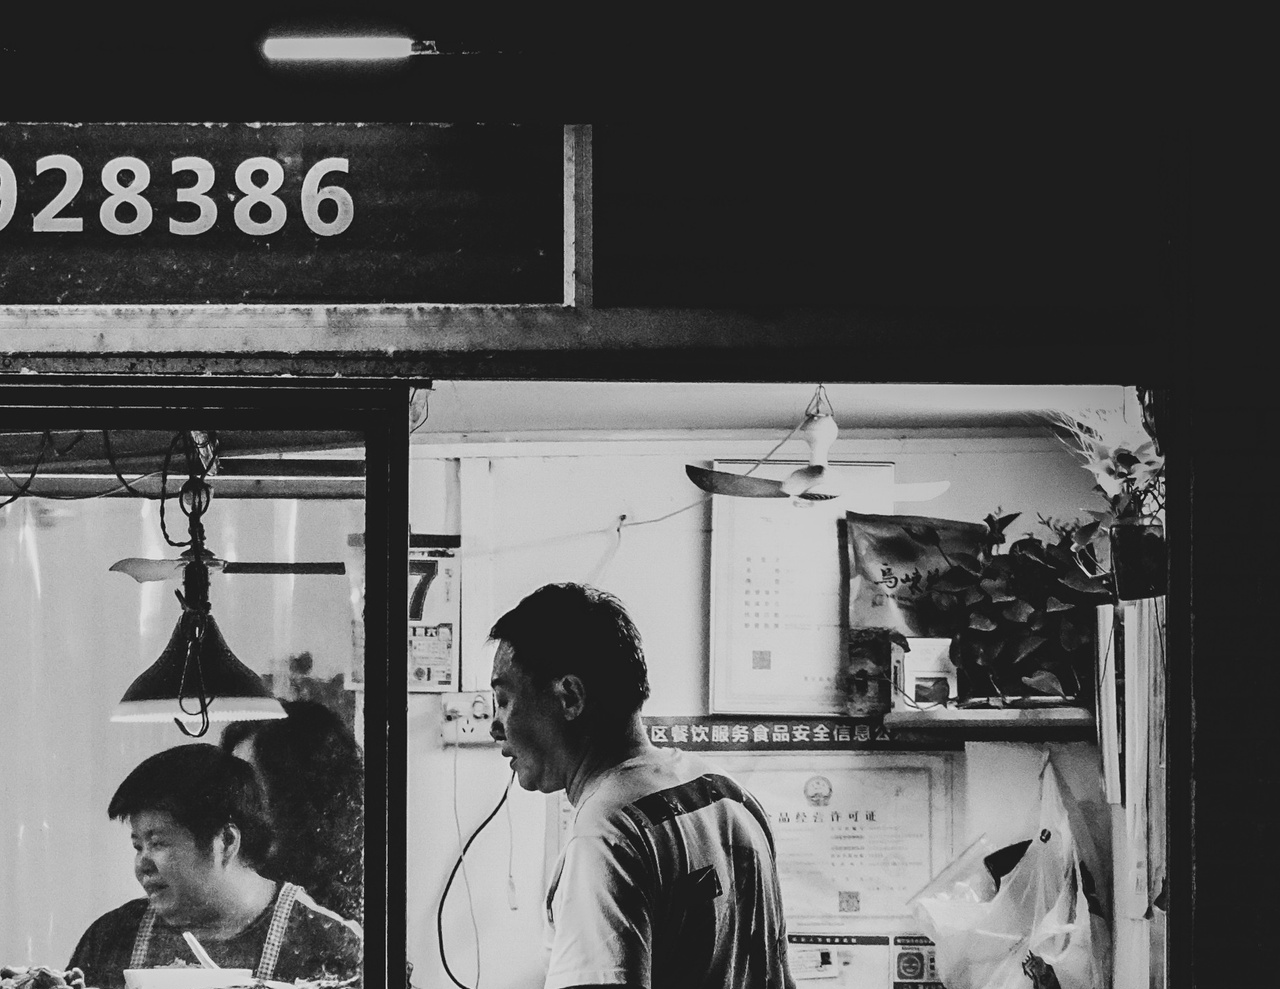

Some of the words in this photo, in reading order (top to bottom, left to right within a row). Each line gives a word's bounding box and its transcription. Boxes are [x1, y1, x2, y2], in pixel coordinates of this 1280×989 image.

[644, 724, 916, 743] 区餐饮服务食品安全信息公
